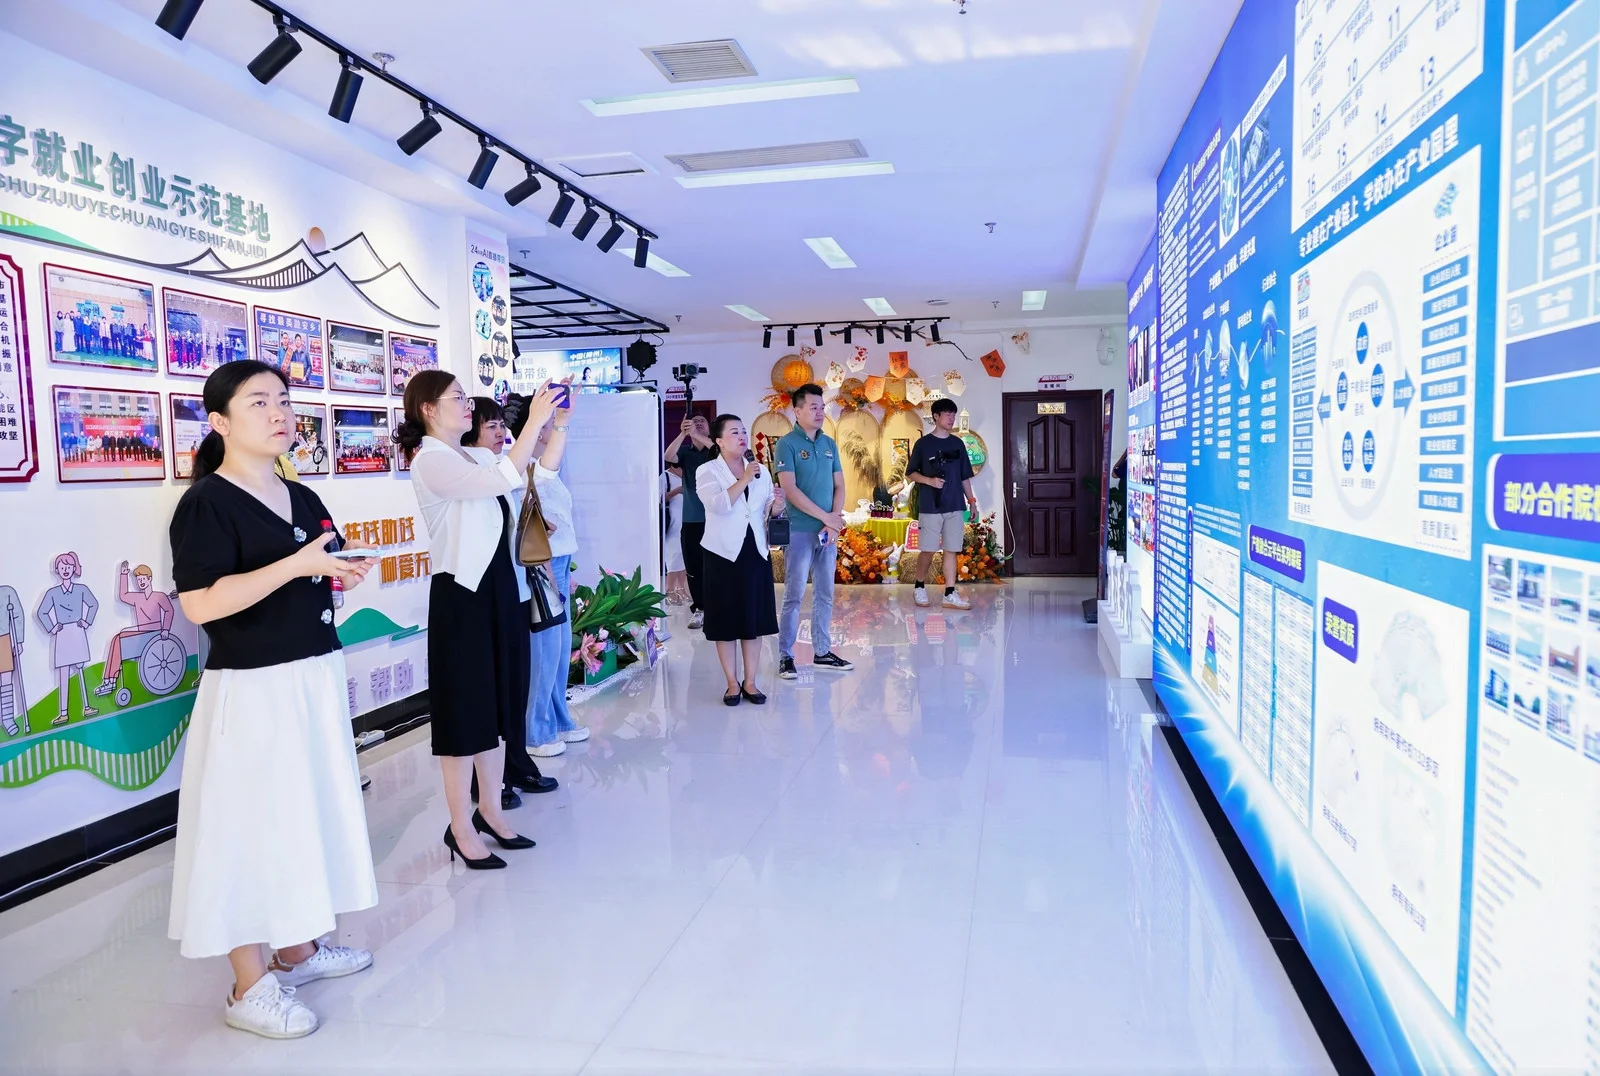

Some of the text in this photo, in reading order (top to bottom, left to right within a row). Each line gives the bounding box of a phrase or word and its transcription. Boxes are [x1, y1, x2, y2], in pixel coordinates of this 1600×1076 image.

[0, 114, 270, 242] 字就业创业示范基地
[1, 321, 8, 331] 合
[259, 312, 320, 331] 寻找最美融安乡
[1, 335, 10, 345] 机
[0, 431, 18, 441] 攻坚
